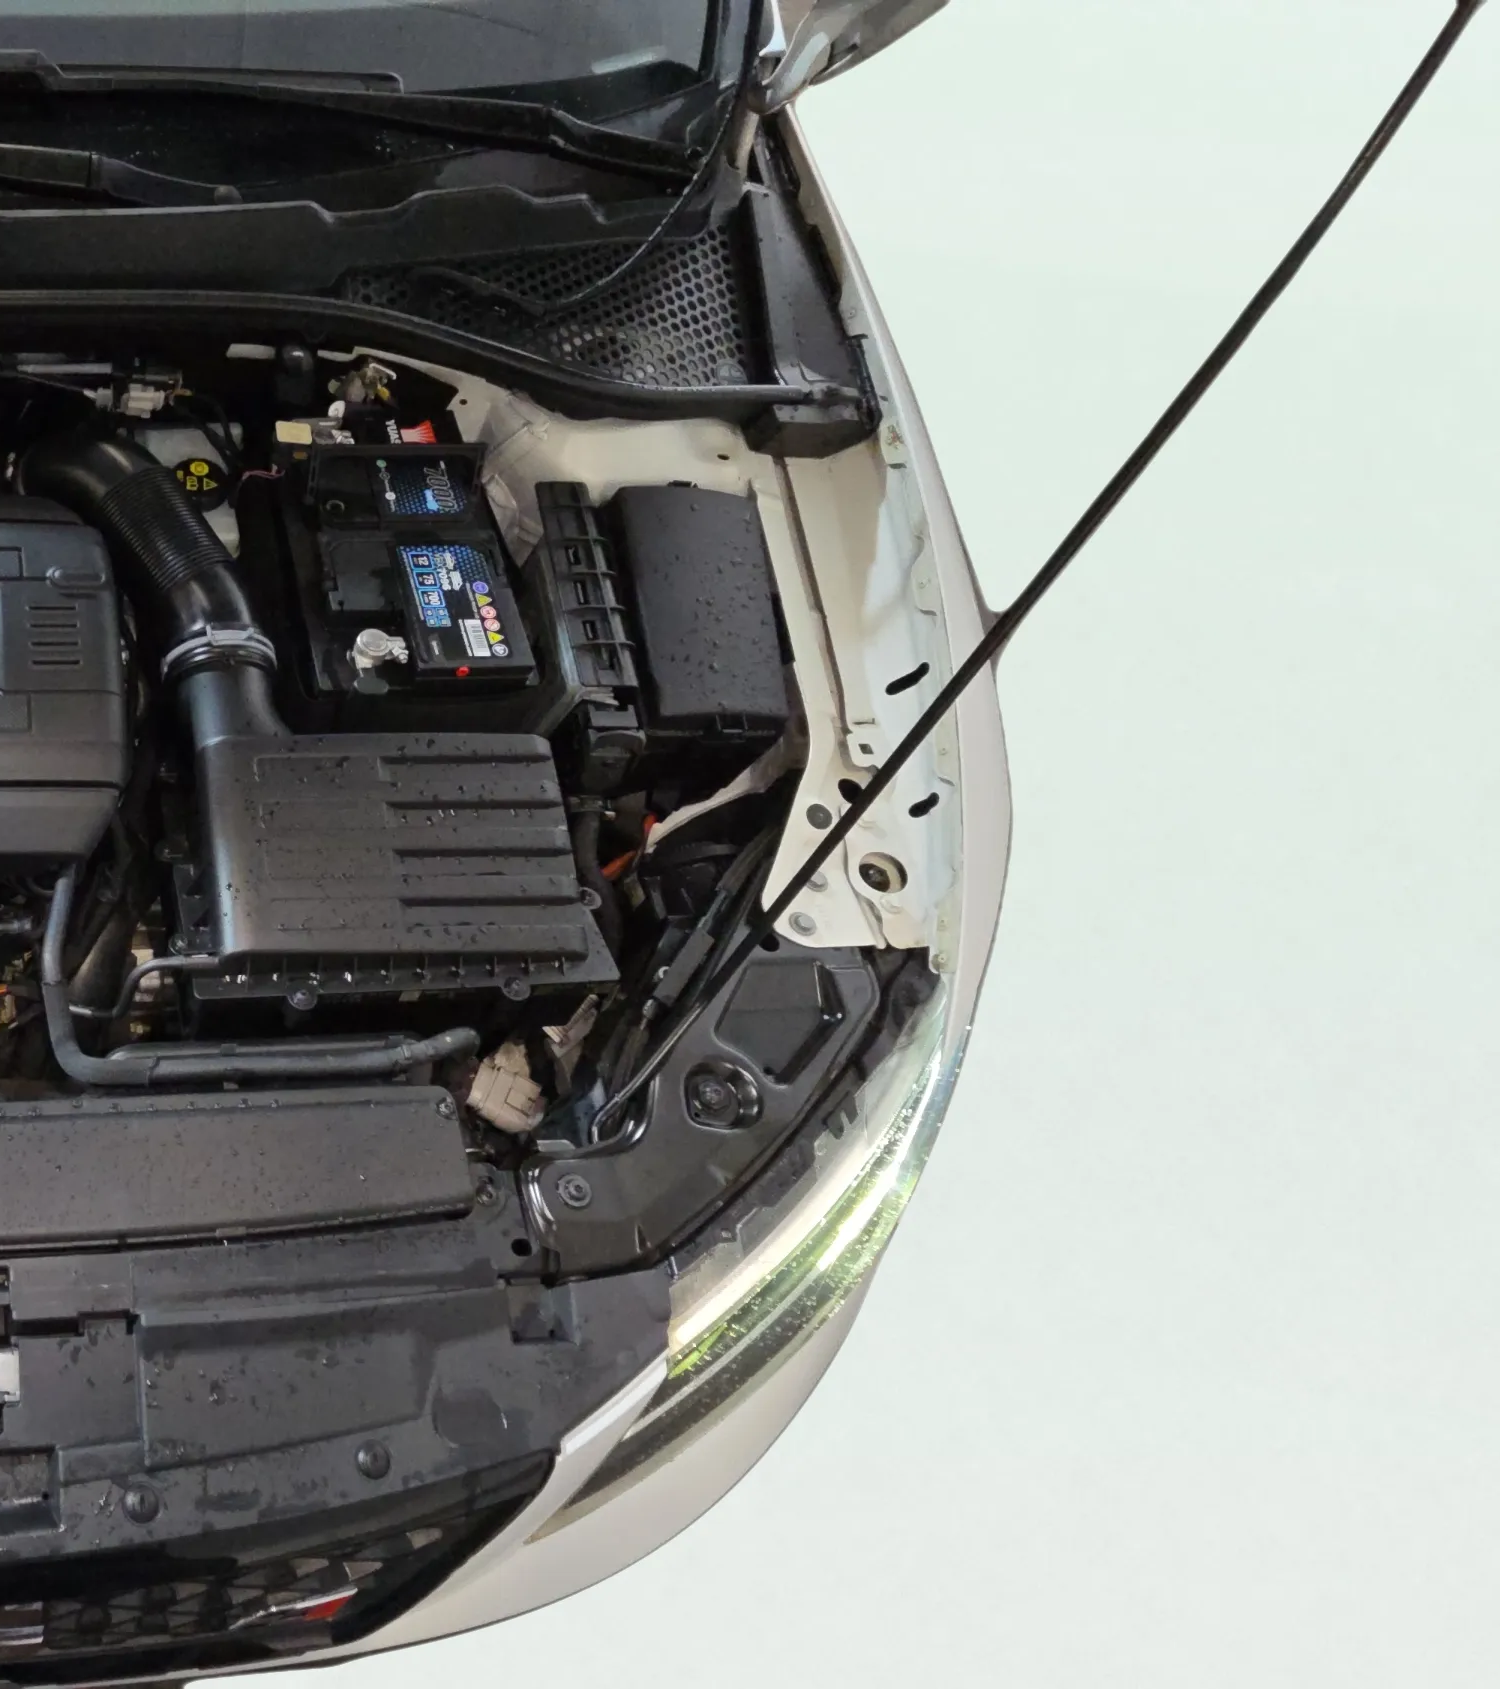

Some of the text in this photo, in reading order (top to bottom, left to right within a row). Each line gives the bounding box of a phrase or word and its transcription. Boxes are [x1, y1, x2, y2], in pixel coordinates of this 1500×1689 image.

[385, 419, 402, 444] YUAS
[422, 574, 435, 585] 75
[427, 591, 441, 605] 700
